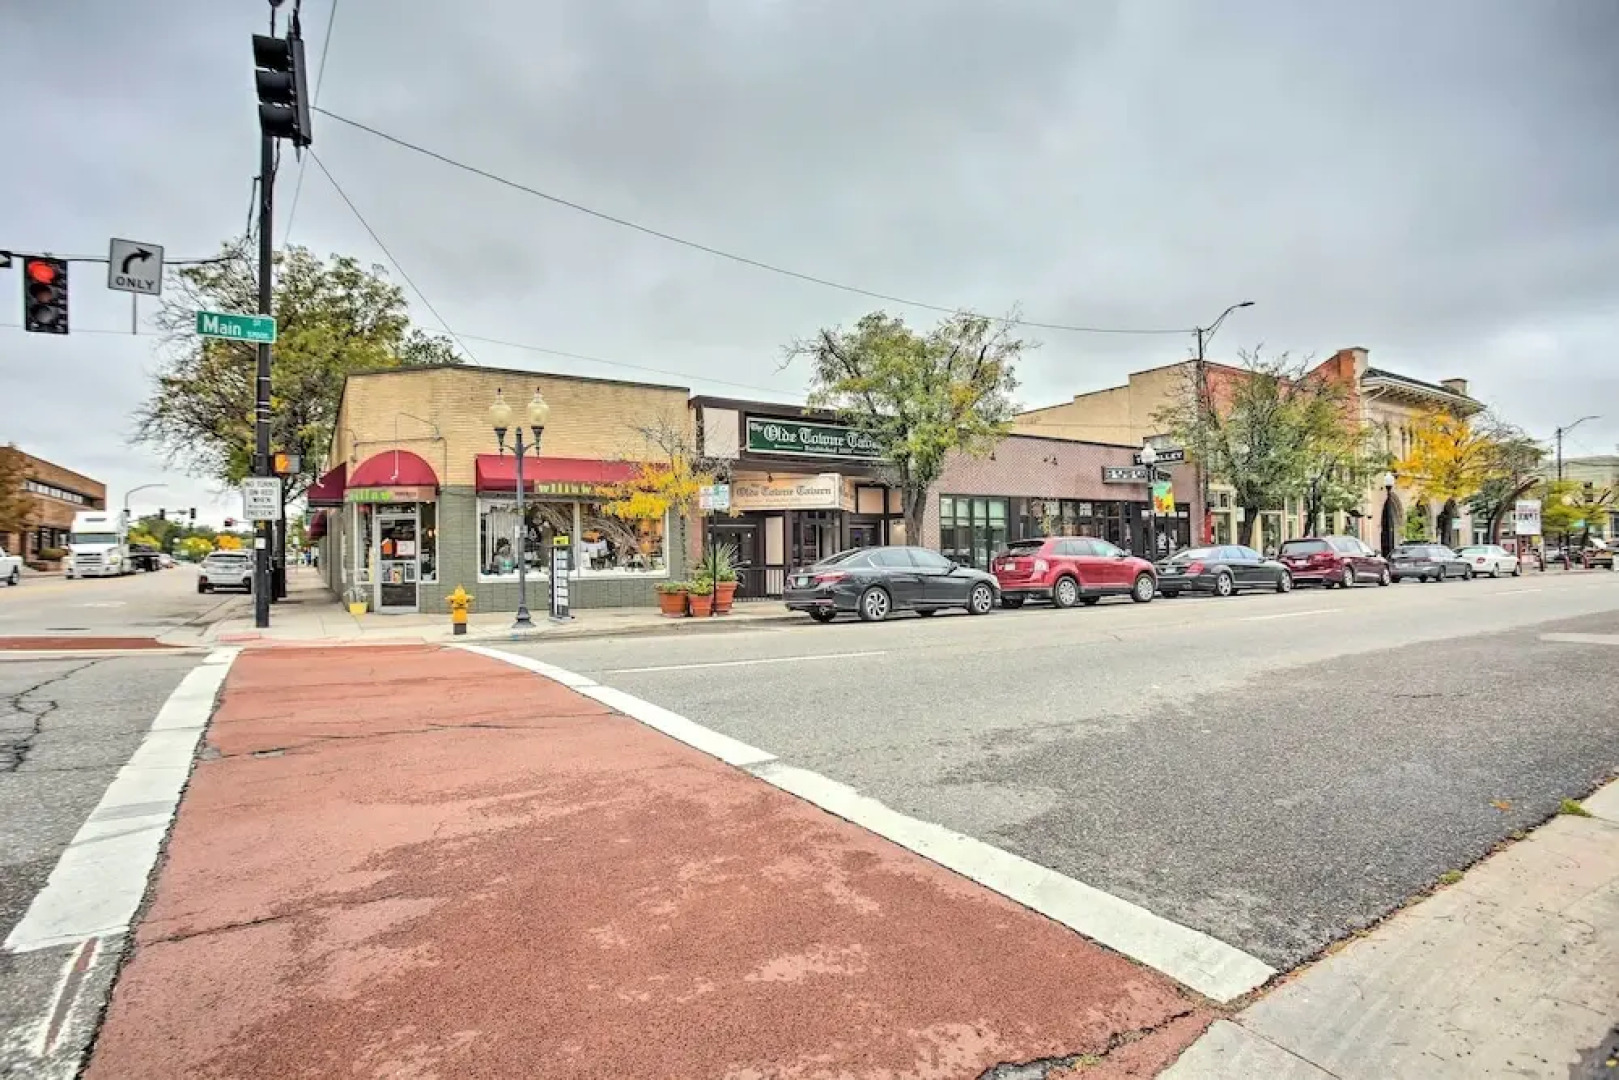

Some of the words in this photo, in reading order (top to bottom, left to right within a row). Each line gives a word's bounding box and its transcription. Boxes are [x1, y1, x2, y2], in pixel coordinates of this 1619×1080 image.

[115, 276, 155, 290] ONLY
[203, 314, 242, 336] Main
[763, 424, 798, 442] Olde
[798, 427, 845, 446] Towne
[736, 487, 760, 498] Olde
[761, 486, 794, 498] Towne
[796, 485, 832, 497] Tavern
